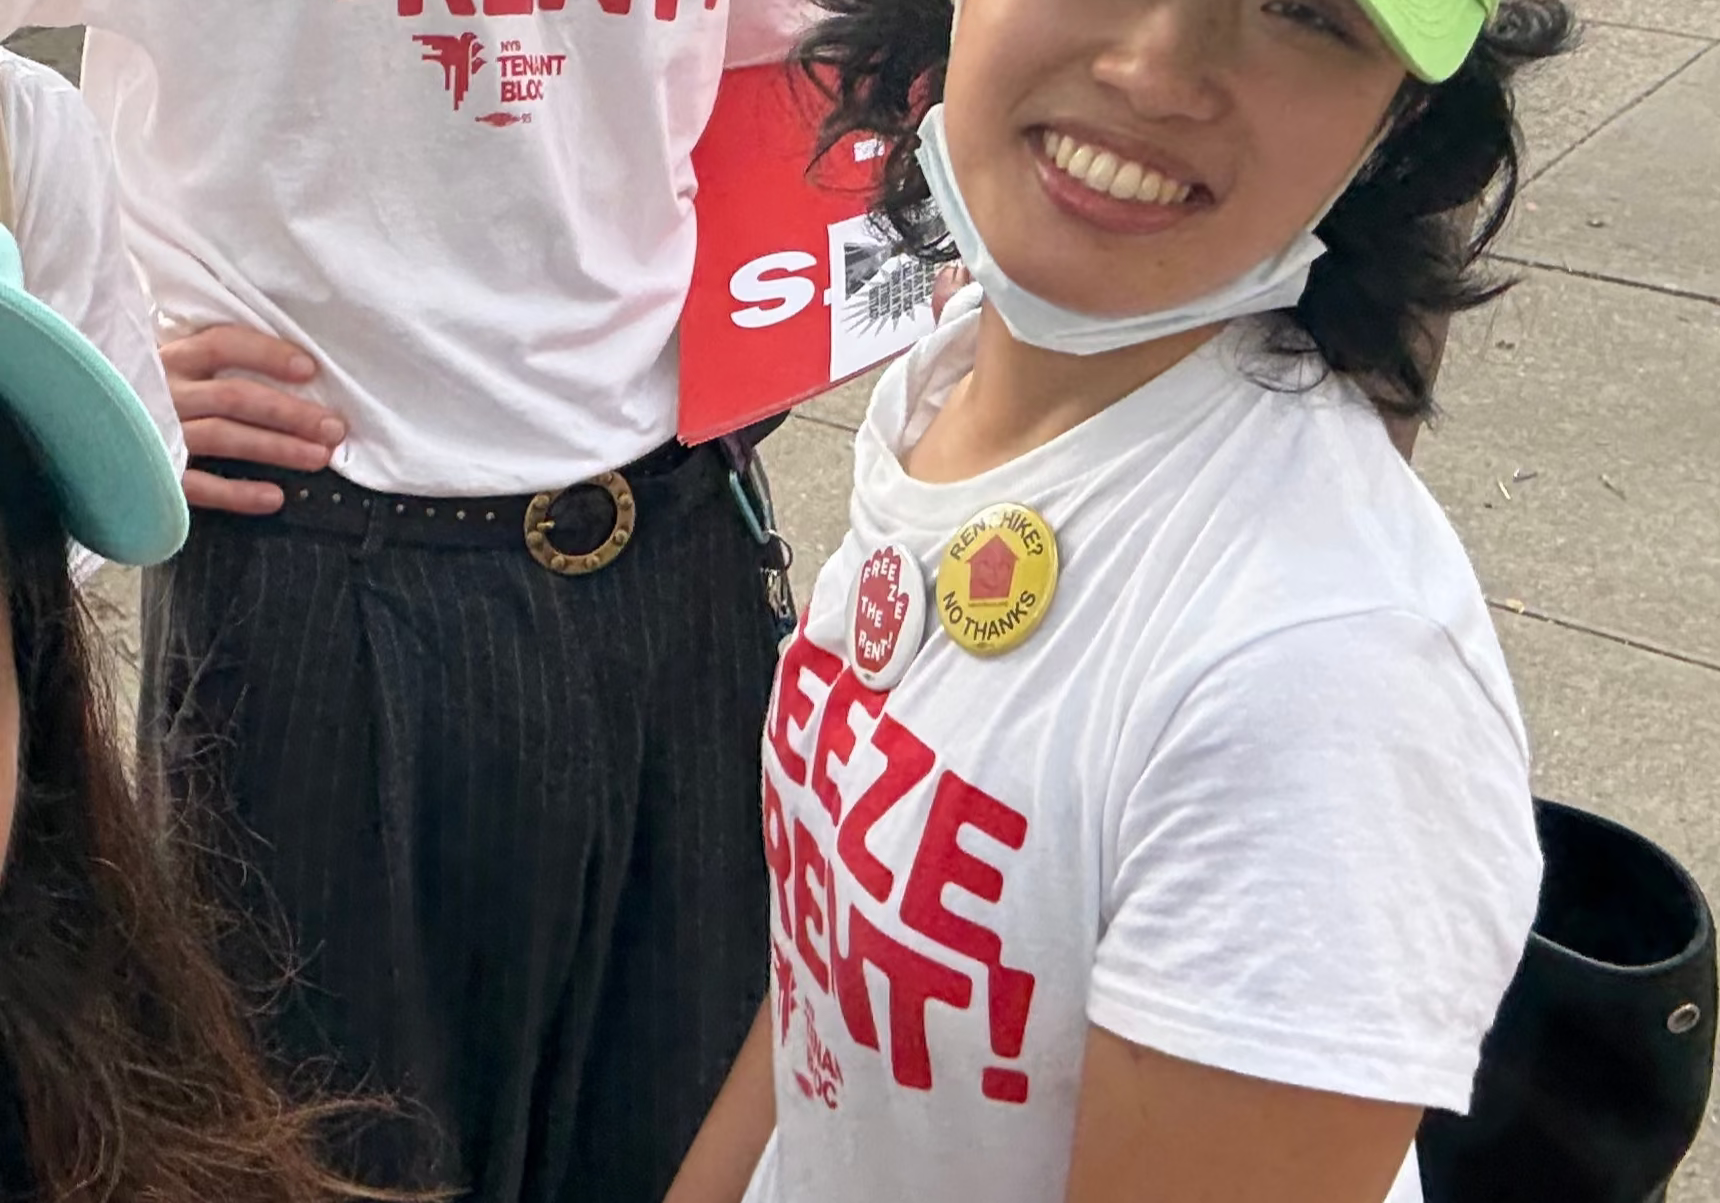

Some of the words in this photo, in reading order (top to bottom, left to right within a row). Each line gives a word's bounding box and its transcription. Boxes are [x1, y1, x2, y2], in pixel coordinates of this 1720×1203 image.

[950, 517, 994, 561] REN
[1000, 510, 1044, 557] HIKE?
[861, 596, 884, 628] THE
[943, 590, 963, 624] NO
[963, 590, 1036, 641] THANKS
[859, 629, 893, 661] RENT!
[769, 616, 1029, 964] EEZE
